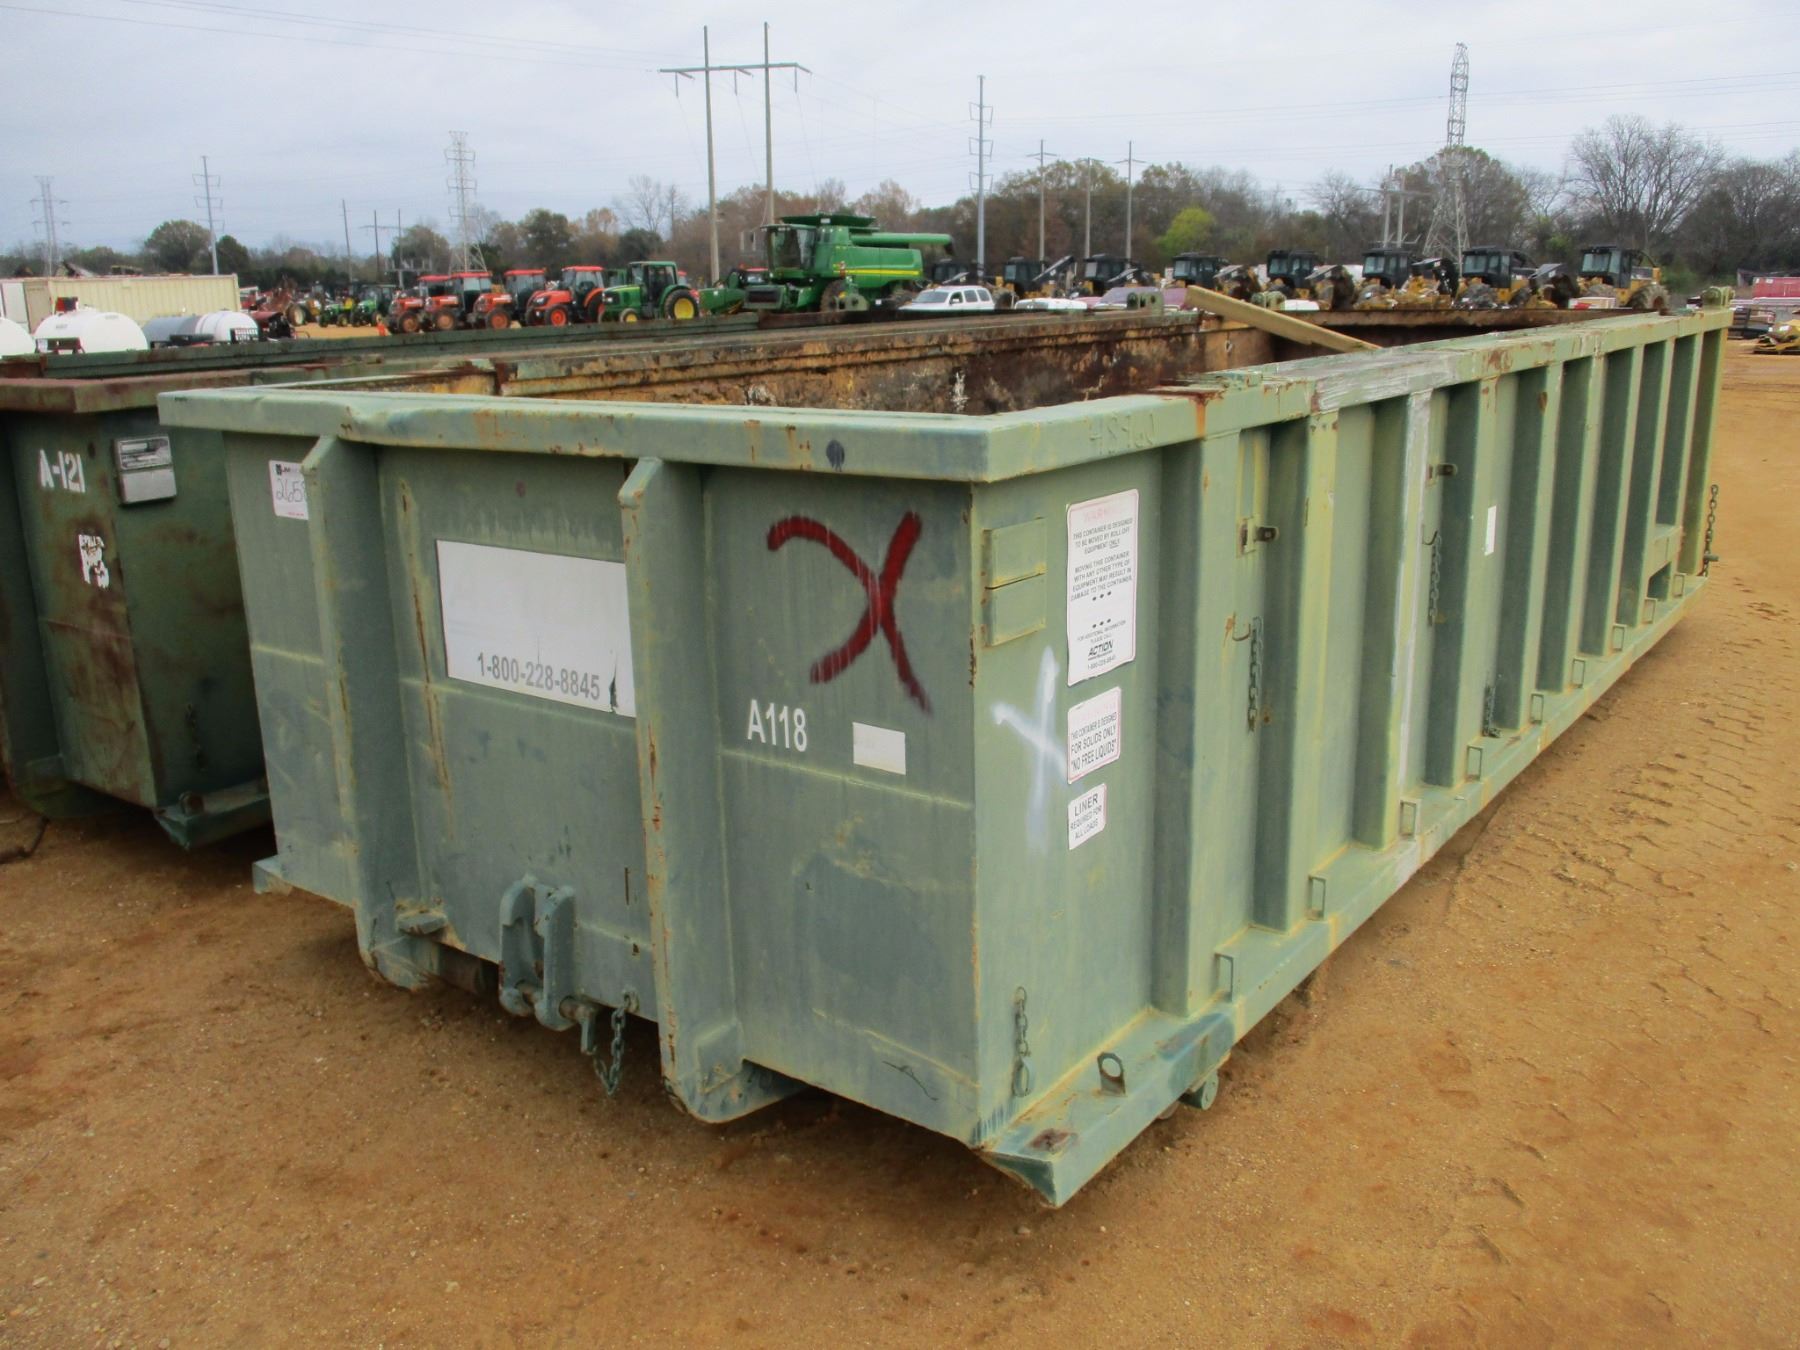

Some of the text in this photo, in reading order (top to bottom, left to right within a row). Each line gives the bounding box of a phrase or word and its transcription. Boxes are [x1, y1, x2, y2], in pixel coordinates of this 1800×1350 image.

[39, 449, 86, 493] A-121
[1088, 640, 1113, 656] ACTION
[477, 652, 600, 700] 1-800-228-8845
[748, 699, 807, 752] A118
[1083, 731, 1102, 749] SOLIDS
[1103, 725, 1116, 739] ONLY
[1082, 750, 1094, 766] FREE
[1075, 793, 1098, 816] LINER
